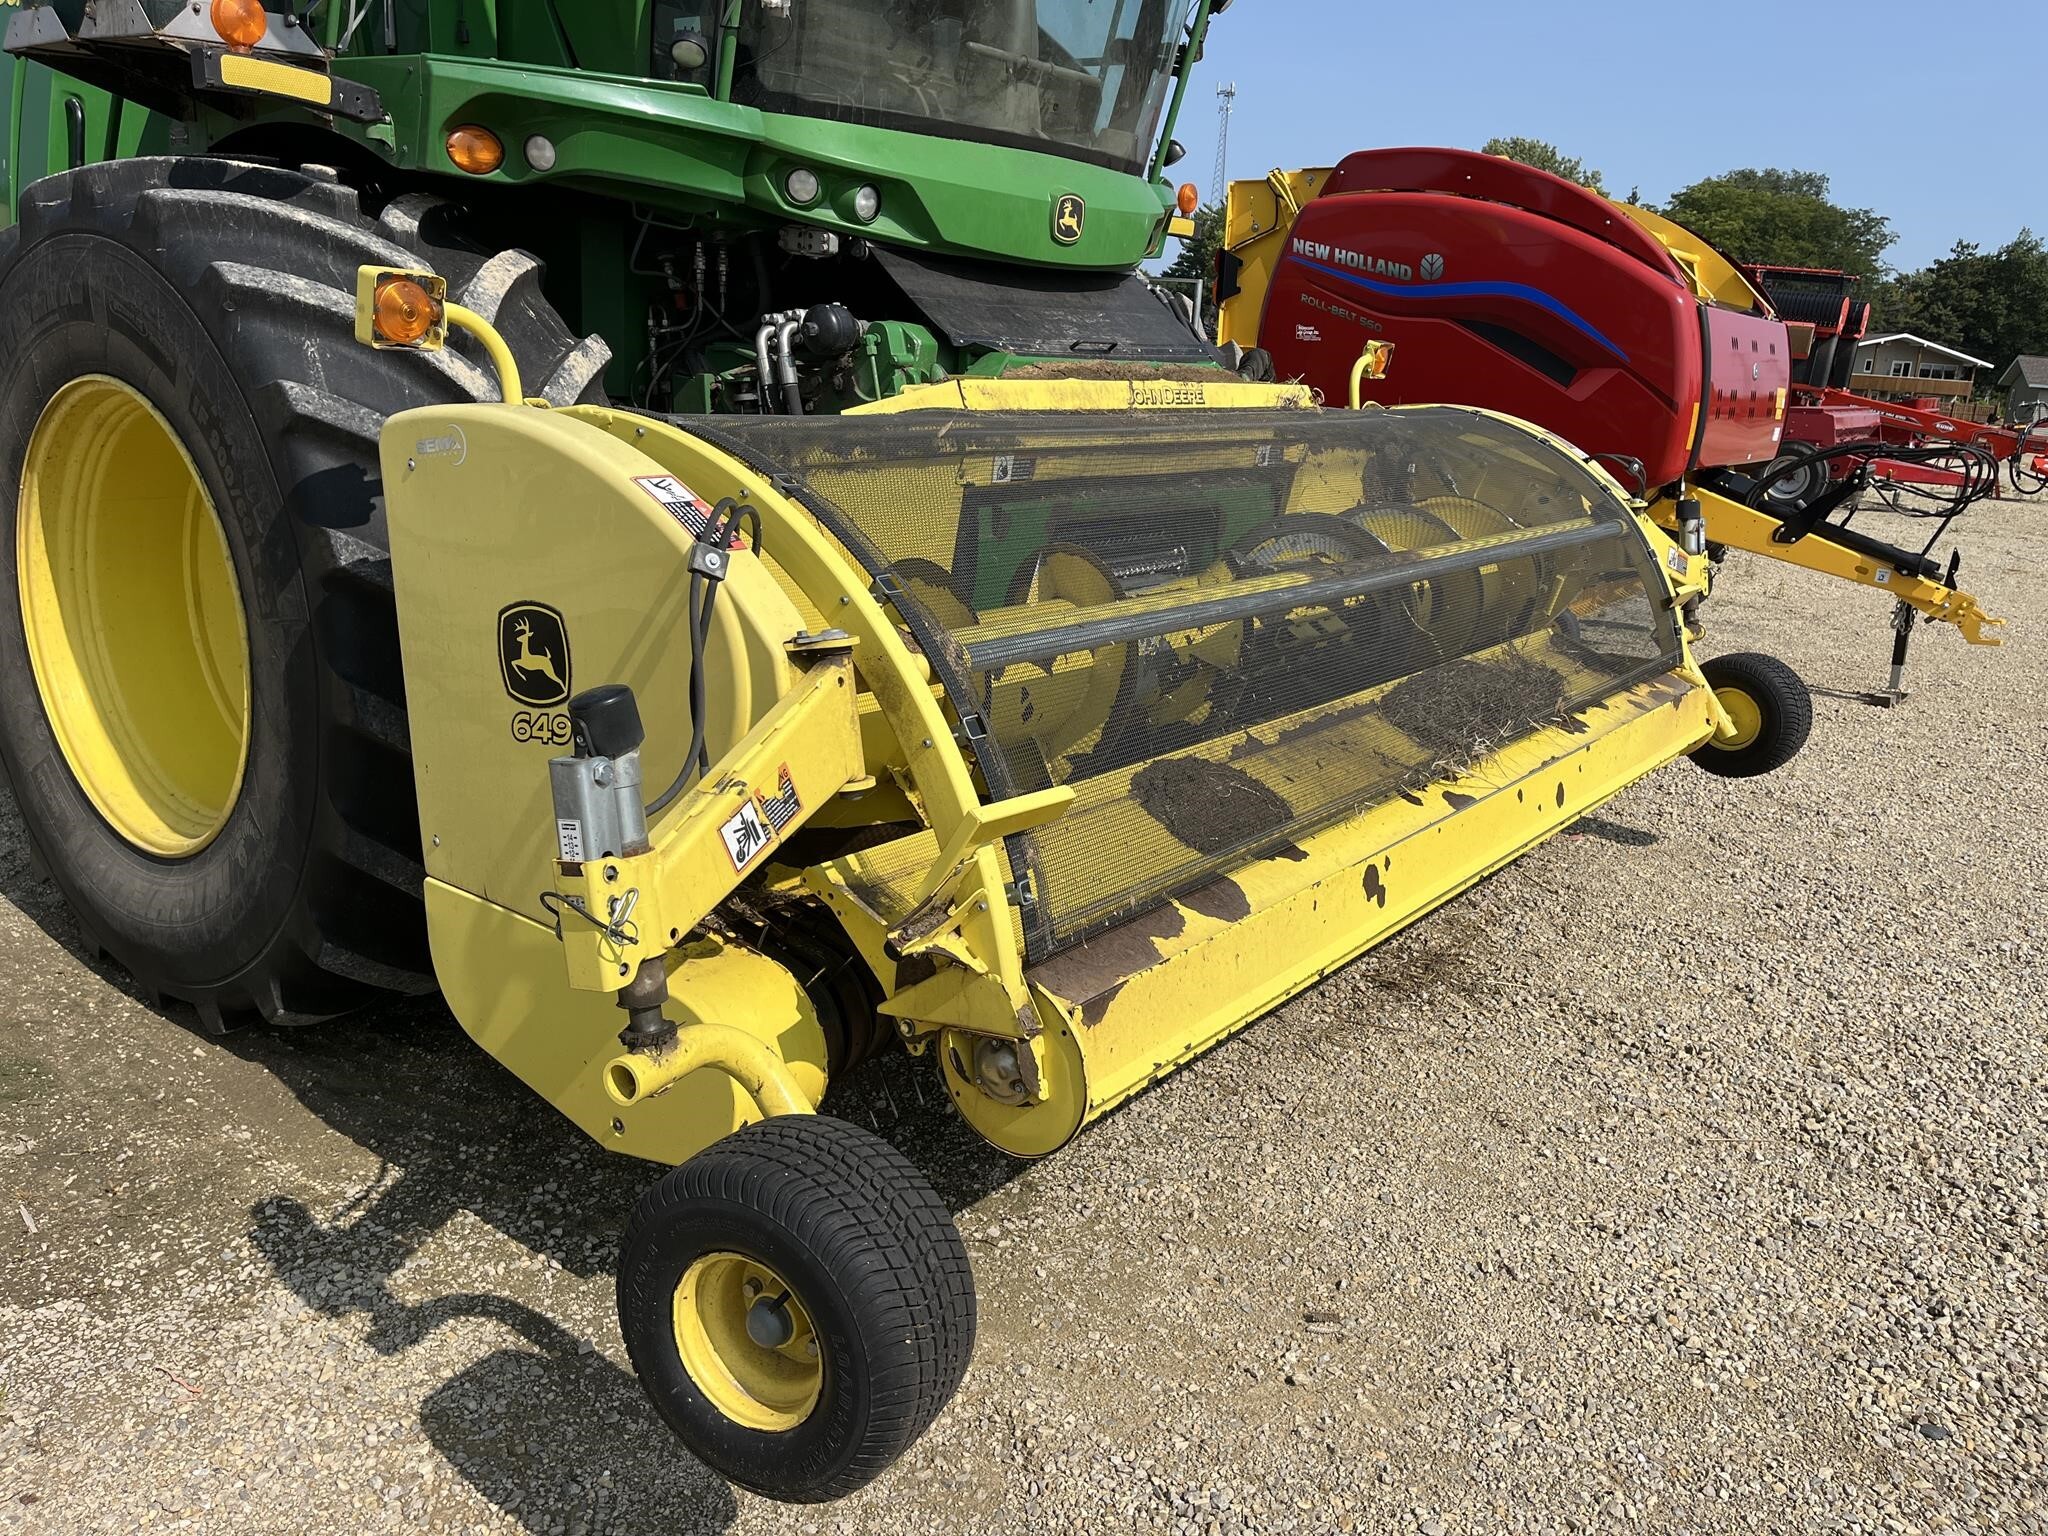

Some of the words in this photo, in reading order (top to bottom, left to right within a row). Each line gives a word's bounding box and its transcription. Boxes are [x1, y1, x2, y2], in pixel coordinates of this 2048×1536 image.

[1293, 237, 1330, 260] NEW
[1334, 247, 1413, 281] HOLLAND
[1301, 293, 1357, 321] ROLL-BELT
[1359, 316, 1383, 333] 550
[1162, 385, 1206, 405] DEERE
[512, 711, 573, 746] 649
